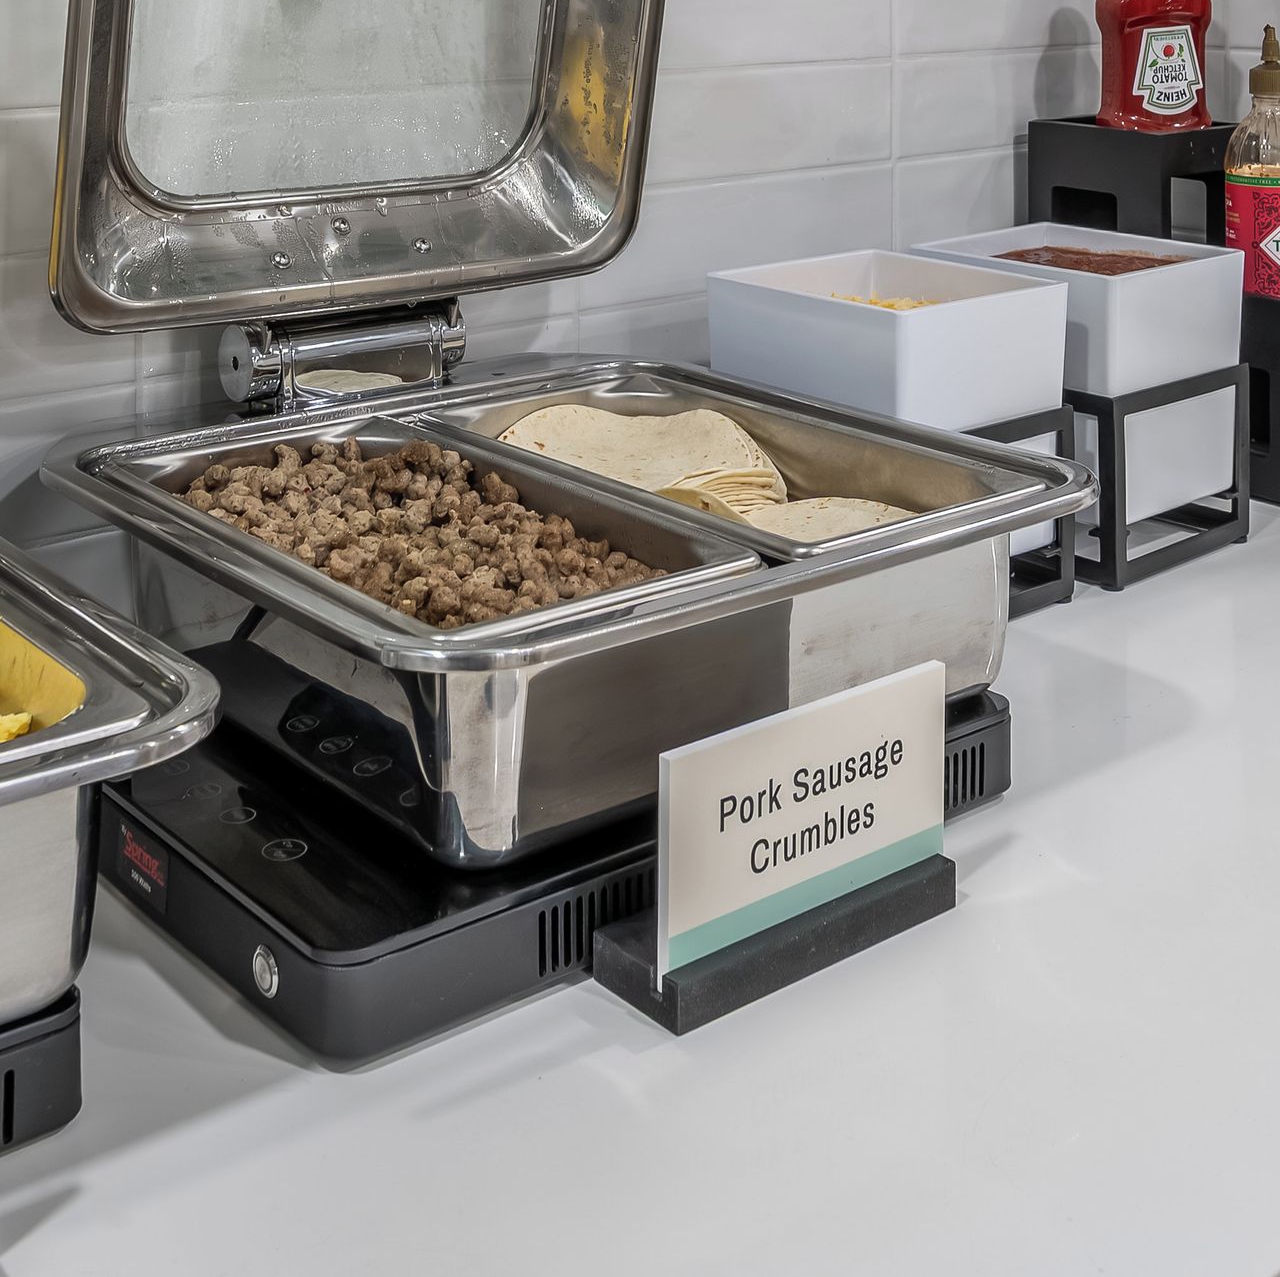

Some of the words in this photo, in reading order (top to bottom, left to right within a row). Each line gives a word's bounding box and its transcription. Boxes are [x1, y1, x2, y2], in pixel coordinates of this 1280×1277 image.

[1153, 64, 1186, 74] KETCHUP
[1152, 72, 1188, 84] TOMATO
[1156, 88, 1187, 102] HEINZ
[719, 778, 782, 833] Pork
[792, 739, 904, 803] Sausage
[750, 802, 876, 874] Crumbles
